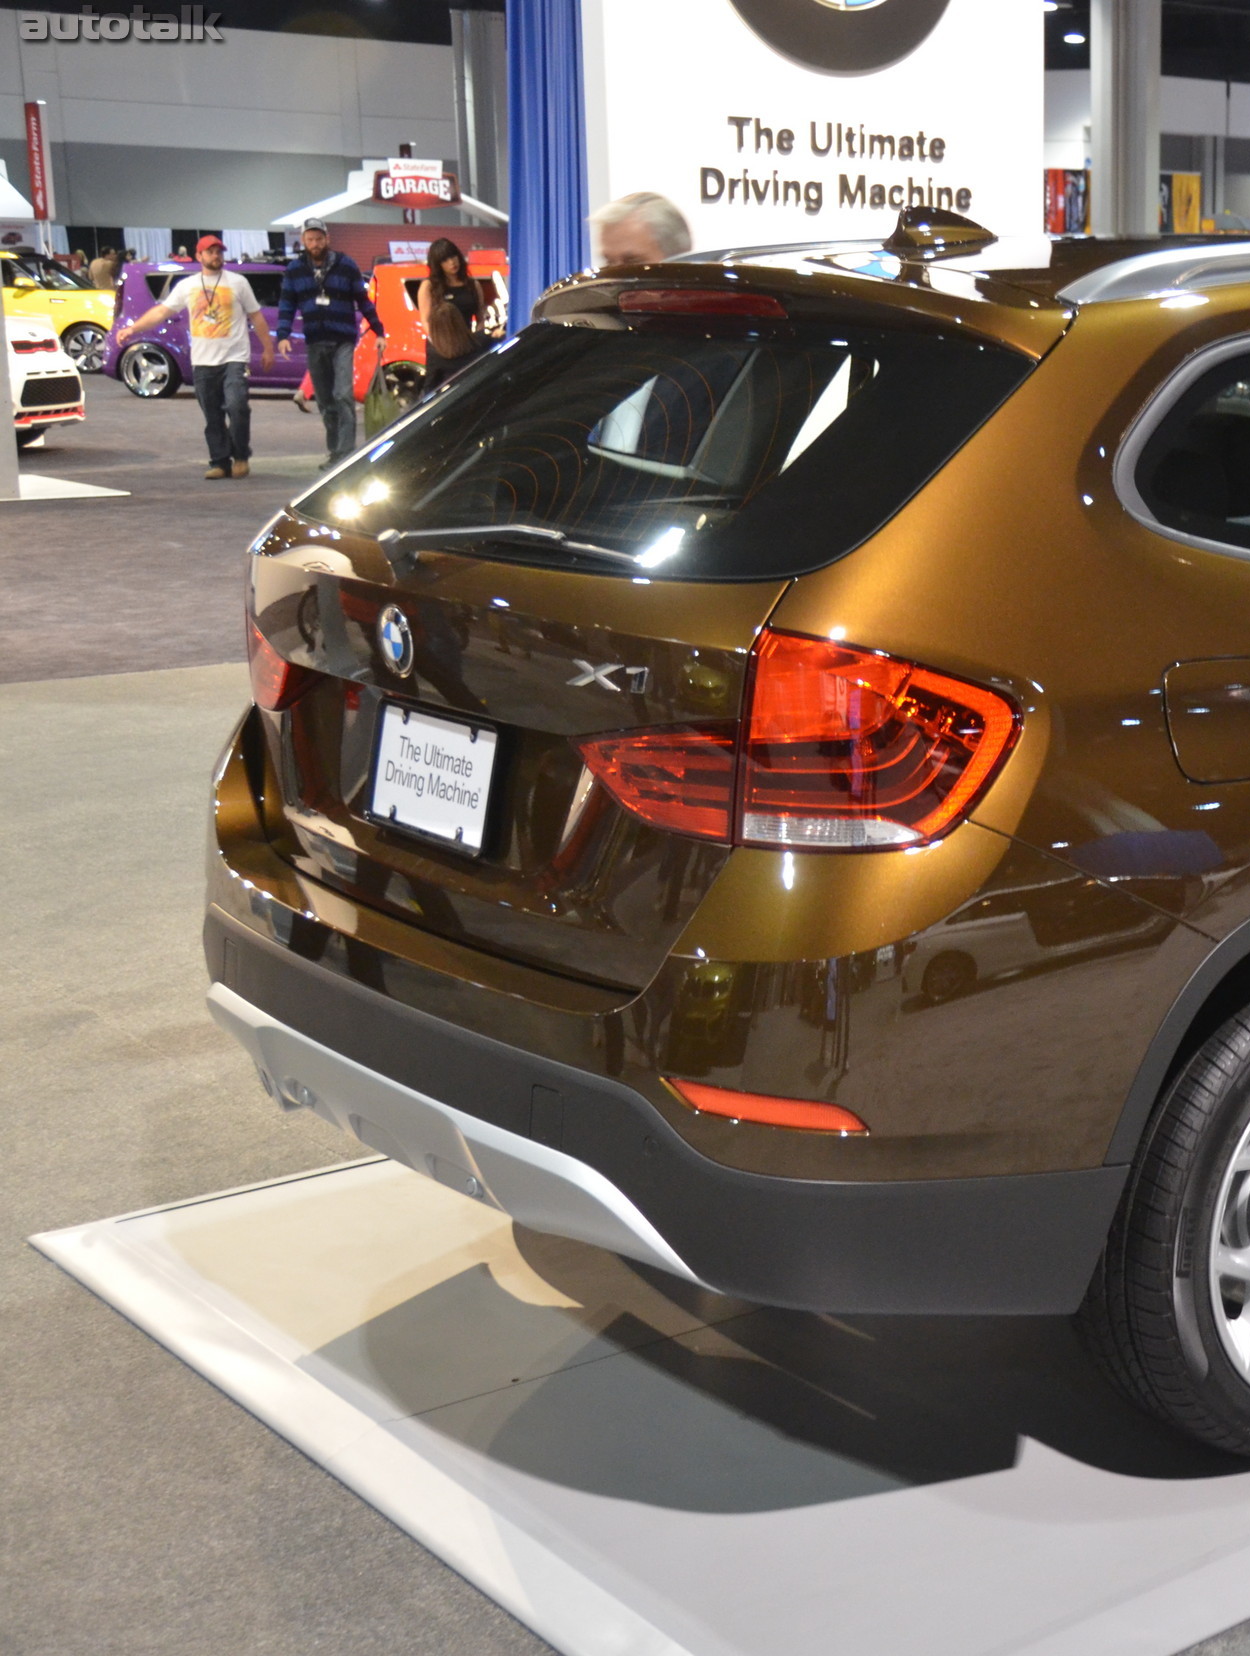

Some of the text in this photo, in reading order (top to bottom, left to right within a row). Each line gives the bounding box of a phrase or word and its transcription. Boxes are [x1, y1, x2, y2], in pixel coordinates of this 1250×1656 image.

[727, 115, 946, 163] The Ultimate
[380, 177, 452, 202] GARAGE
[700, 166, 972, 216] Driving Machine
[565, 658, 649, 695] X1
[399, 735, 474, 779] The Ultimate
[384, 760, 426, 798] Driving
